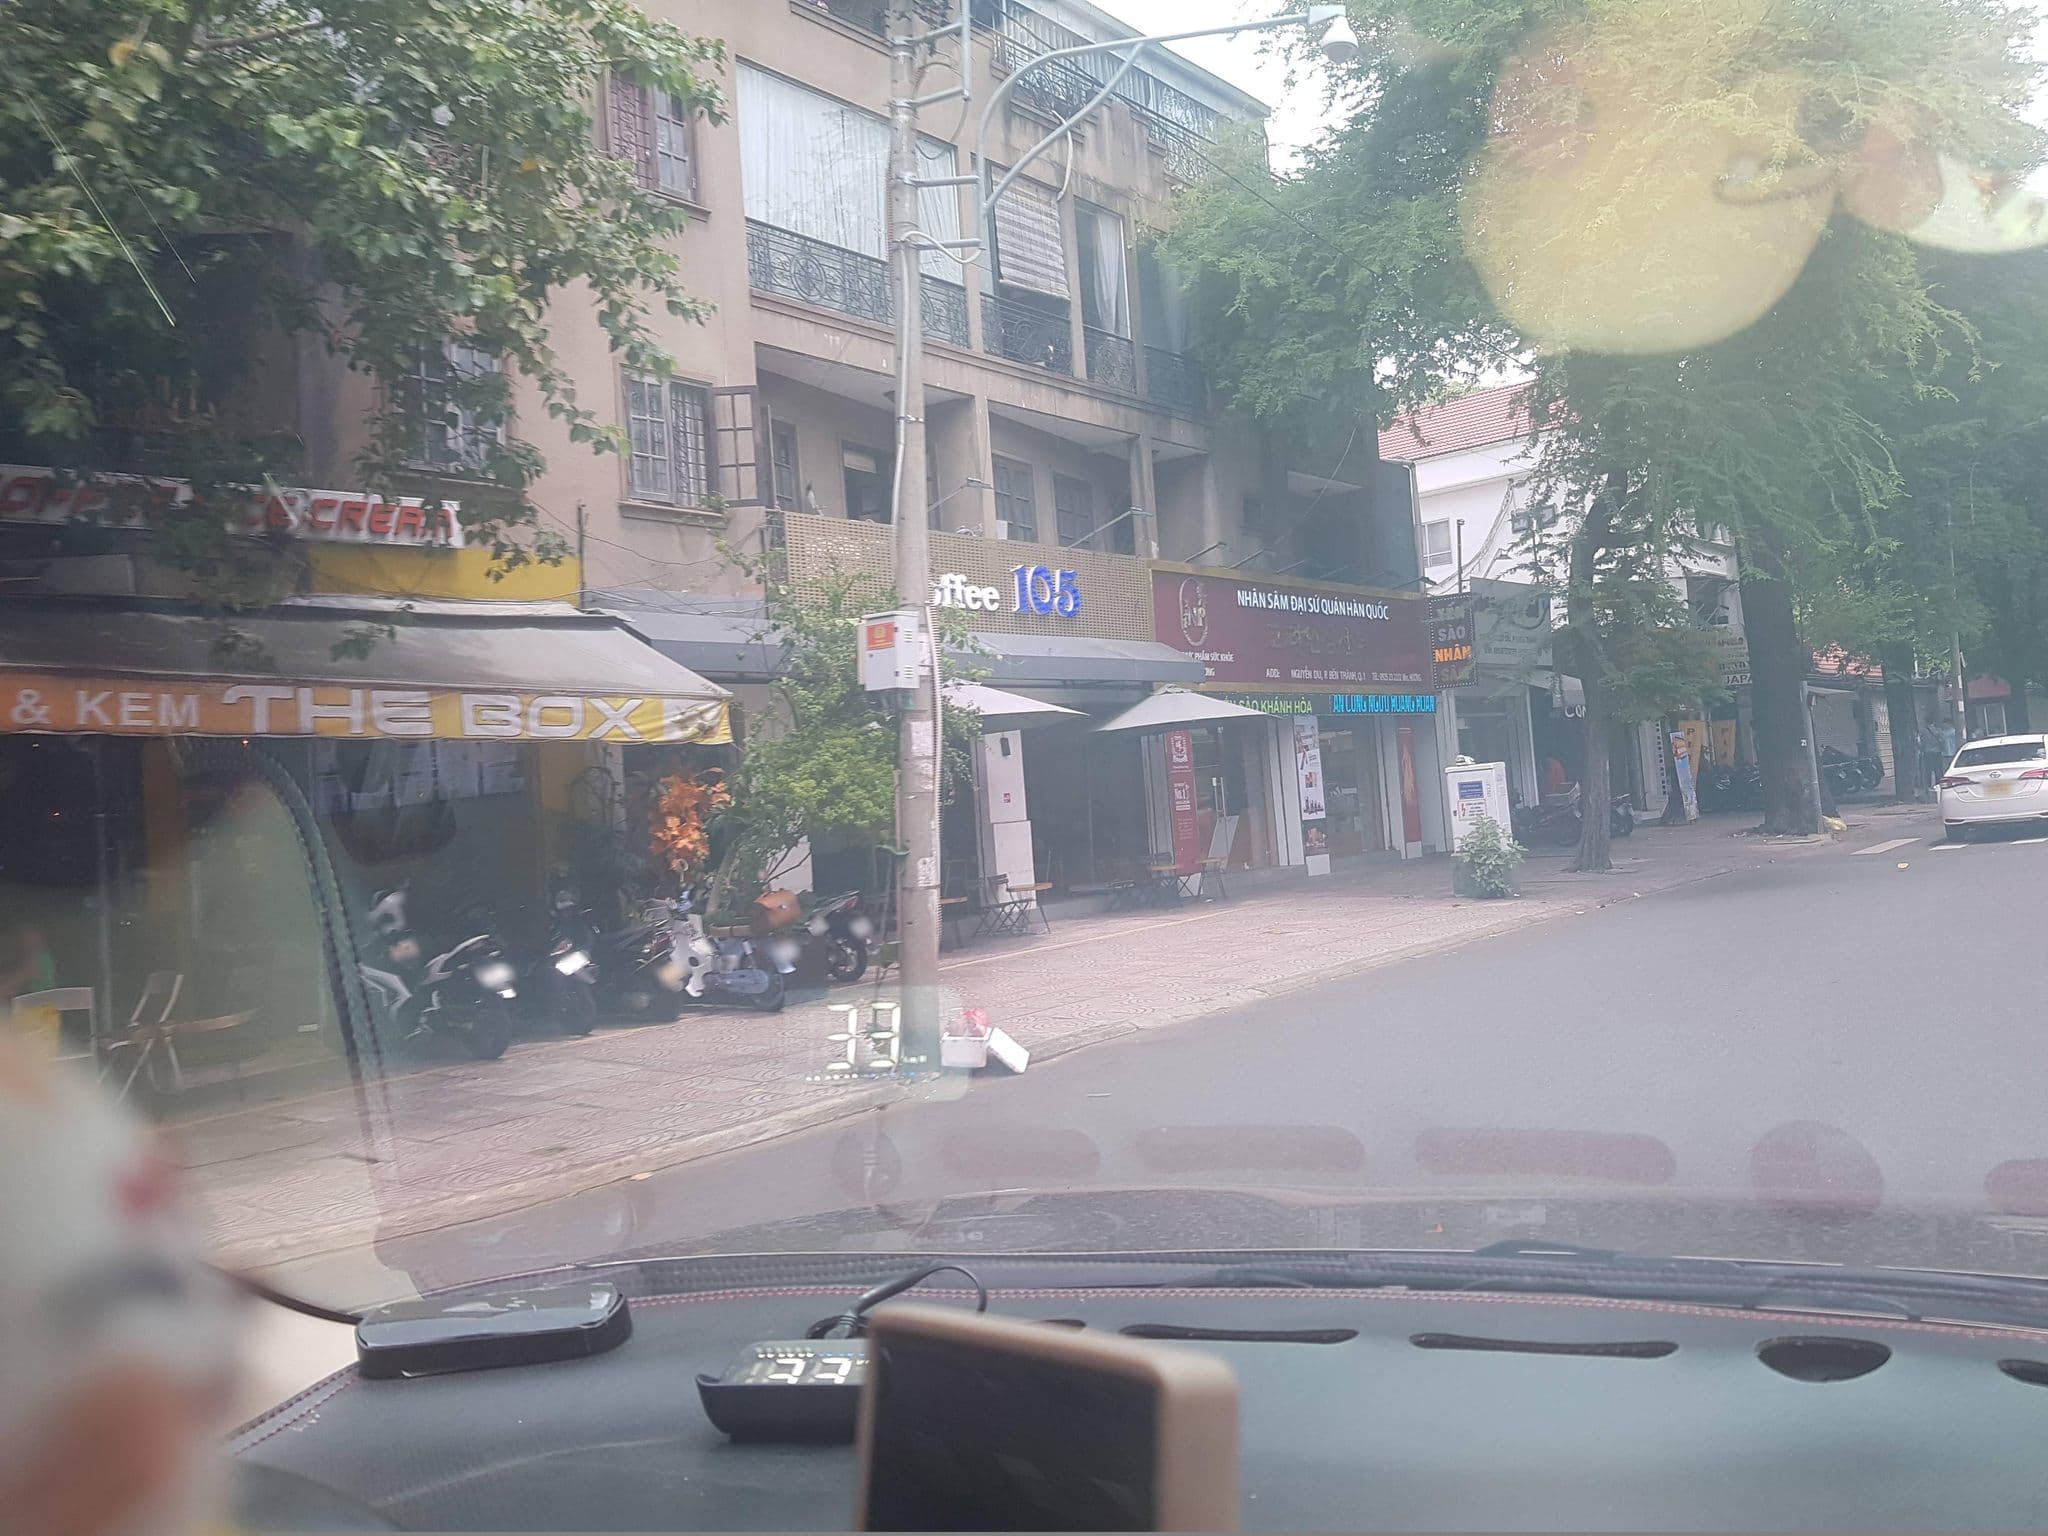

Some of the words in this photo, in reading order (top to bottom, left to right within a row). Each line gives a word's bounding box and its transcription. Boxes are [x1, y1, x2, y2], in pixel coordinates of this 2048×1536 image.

[1010, 565, 1082, 618] 105
[1237, 588, 1266, 609] NHÂN
[1267, 591, 1289, 611] SÂM
[1290, 595, 1306, 615] ĐẠI
[1308, 595, 1320, 614] SỨ
[1321, 597, 1346, 616] QUÁN
[1347, 599, 1365, 618] HÀN
[1365, 602, 1389, 620] QUỐC
[10, 688, 49, 724] &
[76, 690, 199, 727] KEM
[221, 685, 433, 735] THE
[460, 693, 643, 739] BOX
[1261, 696, 1293, 714] KHÁNH
[1294, 696, 1313, 714] HÒA
